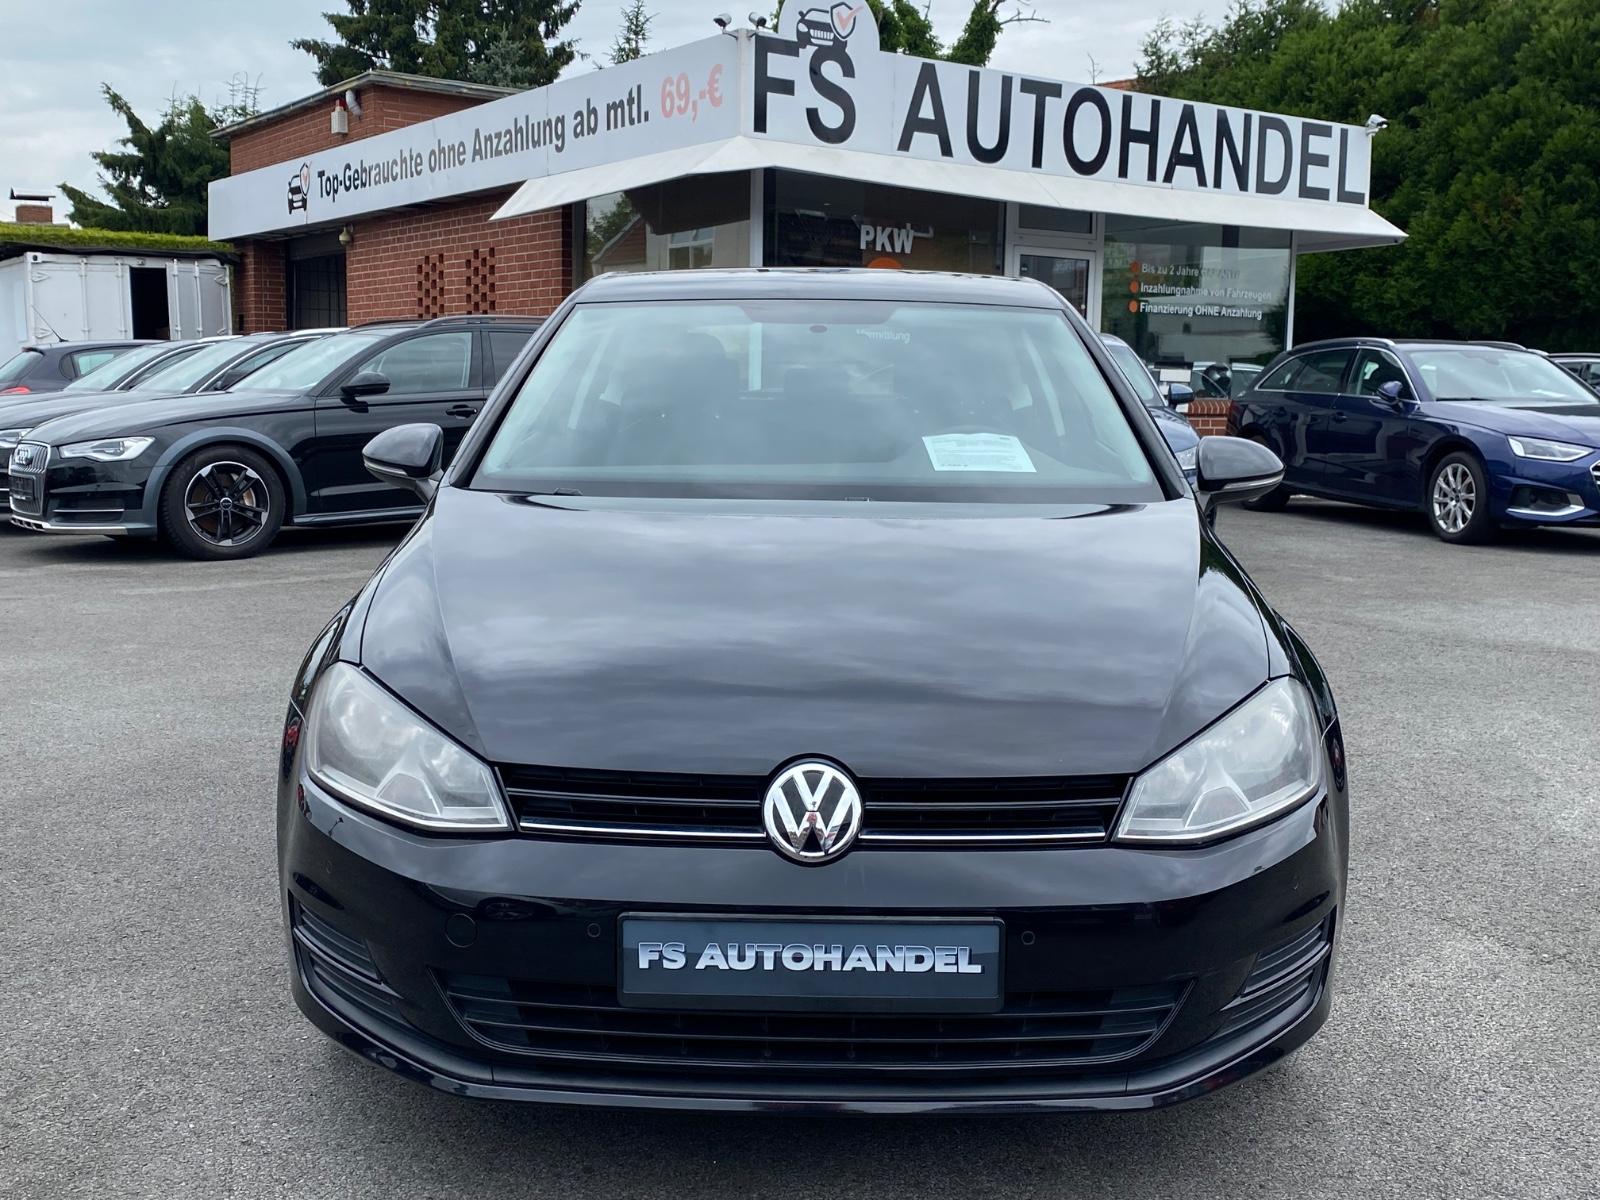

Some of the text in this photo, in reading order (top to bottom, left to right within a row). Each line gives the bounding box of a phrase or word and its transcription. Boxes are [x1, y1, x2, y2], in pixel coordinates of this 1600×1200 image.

[753, 35, 1366, 204] FS AUTOHANDEL
[317, 149, 423, 202] Top-Gebrauchte
[428, 138, 467, 173] ohne
[472, 114, 566, 163] Anzahlung
[573, 98, 599, 139] ab
[606, 84, 650, 131] mtl.
[860, 224, 914, 254] PKW
[1141, 263, 1155, 274] Bis
[1169, 264, 1175, 276] 2
[1176, 265, 1200, 277] Jahre
[1140, 282, 1272, 302] Inzahlungnahme von Fahrzeugen
[1139, 301, 1263, 321] Finanzierung OHNE Anzahlung
[637, 942, 984, 975] FS AUTOHANDEL
